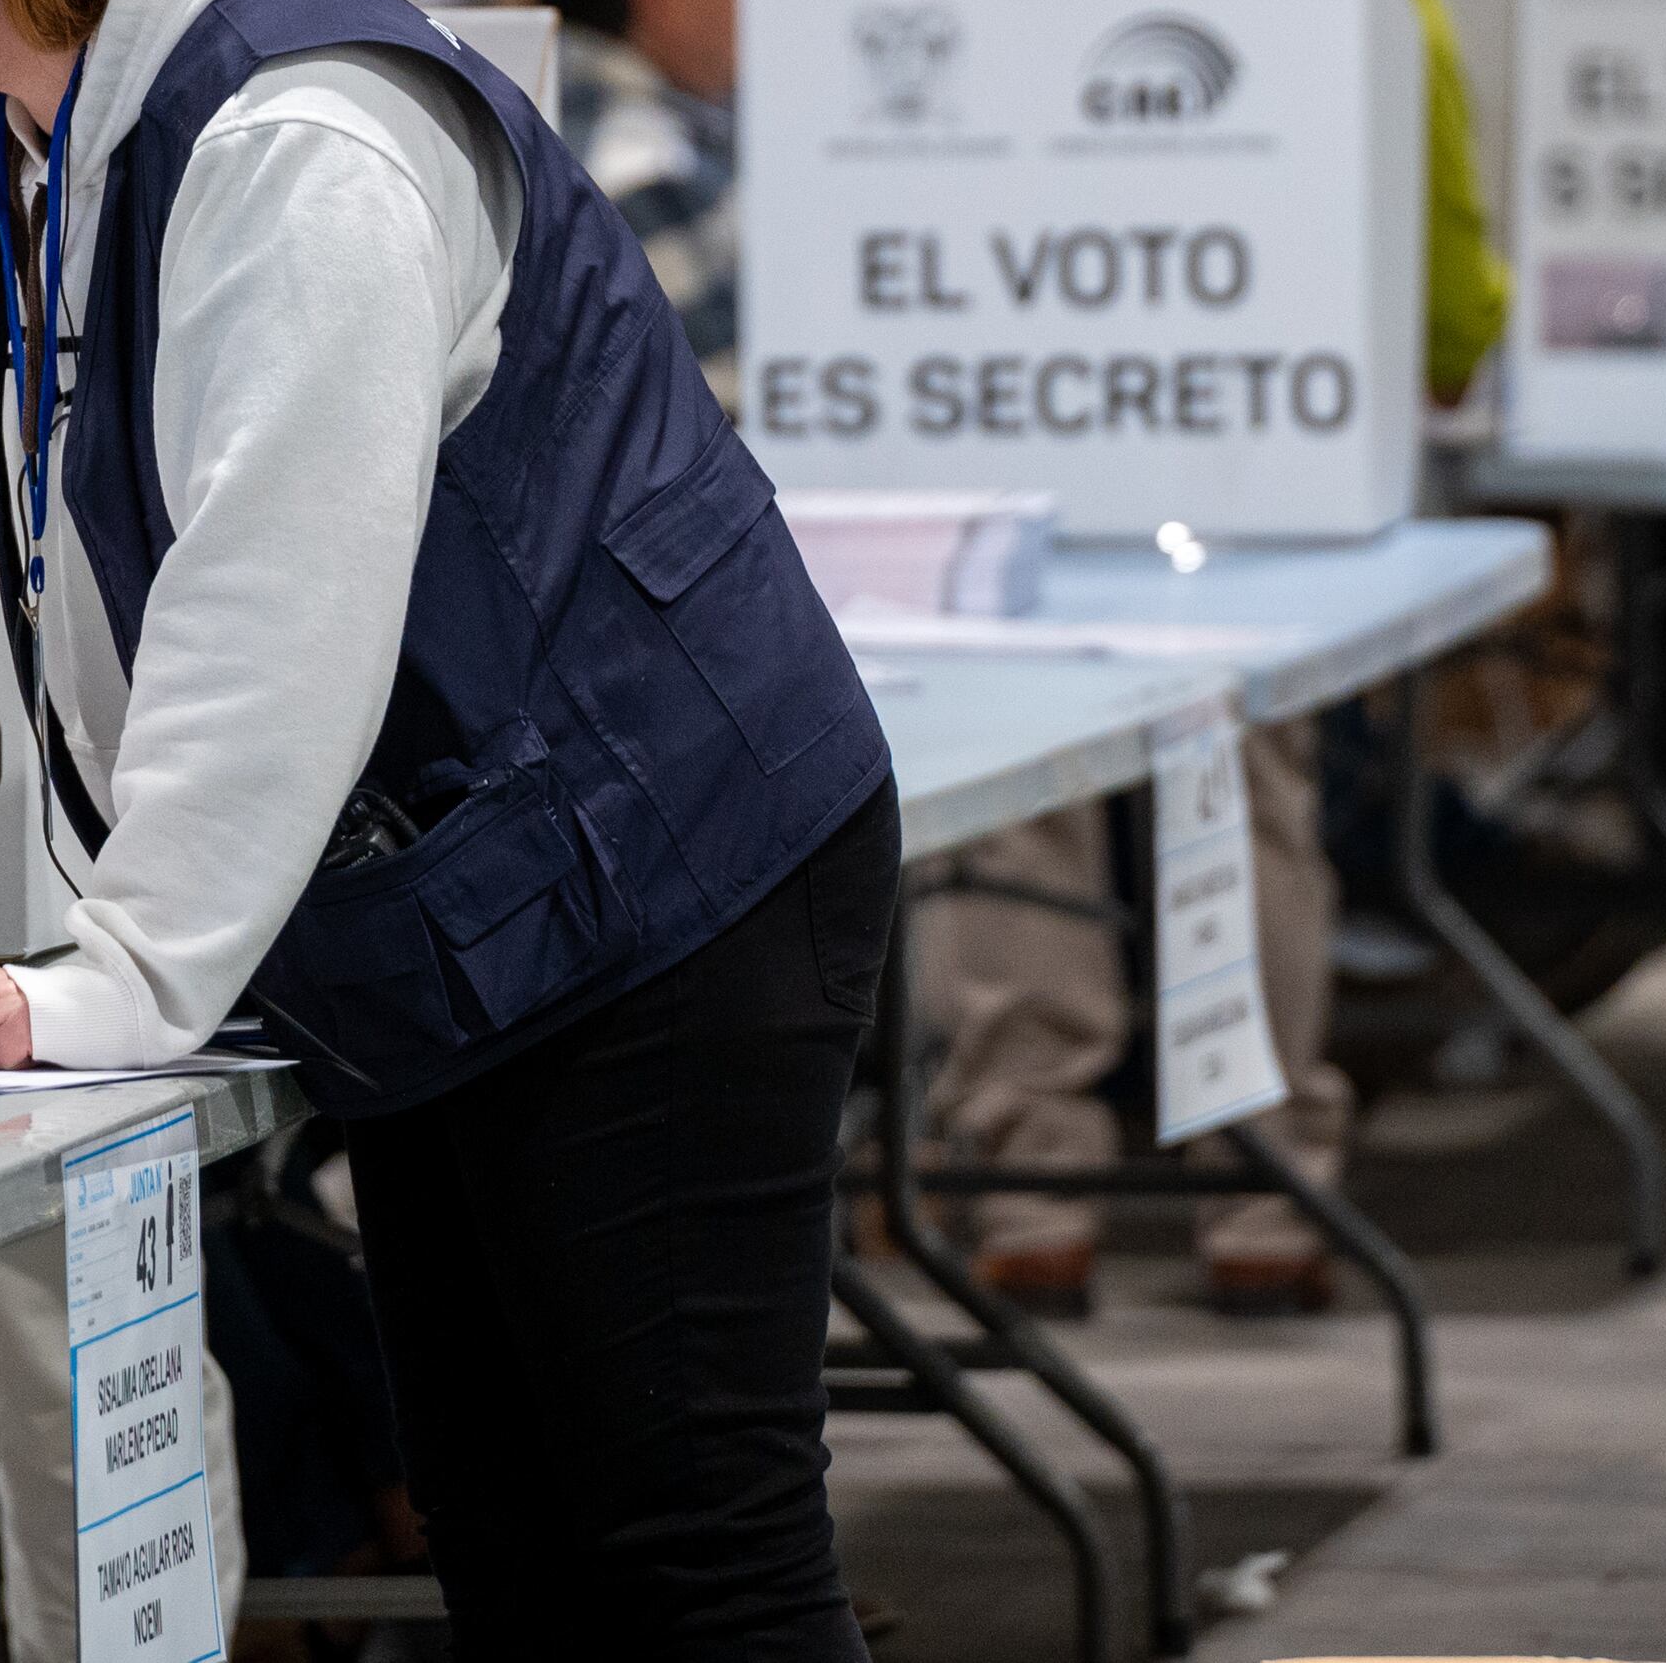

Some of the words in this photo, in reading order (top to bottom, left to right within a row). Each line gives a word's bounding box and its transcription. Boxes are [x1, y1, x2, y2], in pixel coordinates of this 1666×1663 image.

[859, 228, 971, 310] EL
[989, 226, 1253, 310] VOTO
[761, 356, 878, 438] ES
[908, 353, 1358, 438] SECRETO
[130, 1167, 156, 1205] JUNTA
[136, 1215, 156, 1293] 43
[98, 1365, 138, 1417] SISALIMA
[138, 1344, 183, 1398] ORELLANA
[105, 1422, 145, 1475] MARLENE
[146, 1407, 179, 1457] PIEDAD
[98, 1552, 131, 1602] TAMAYO
[133, 1533, 172, 1587] AGUILAR
[171, 1521, 196, 1568] ROSA
[133, 1598, 163, 1647] NOEMI
